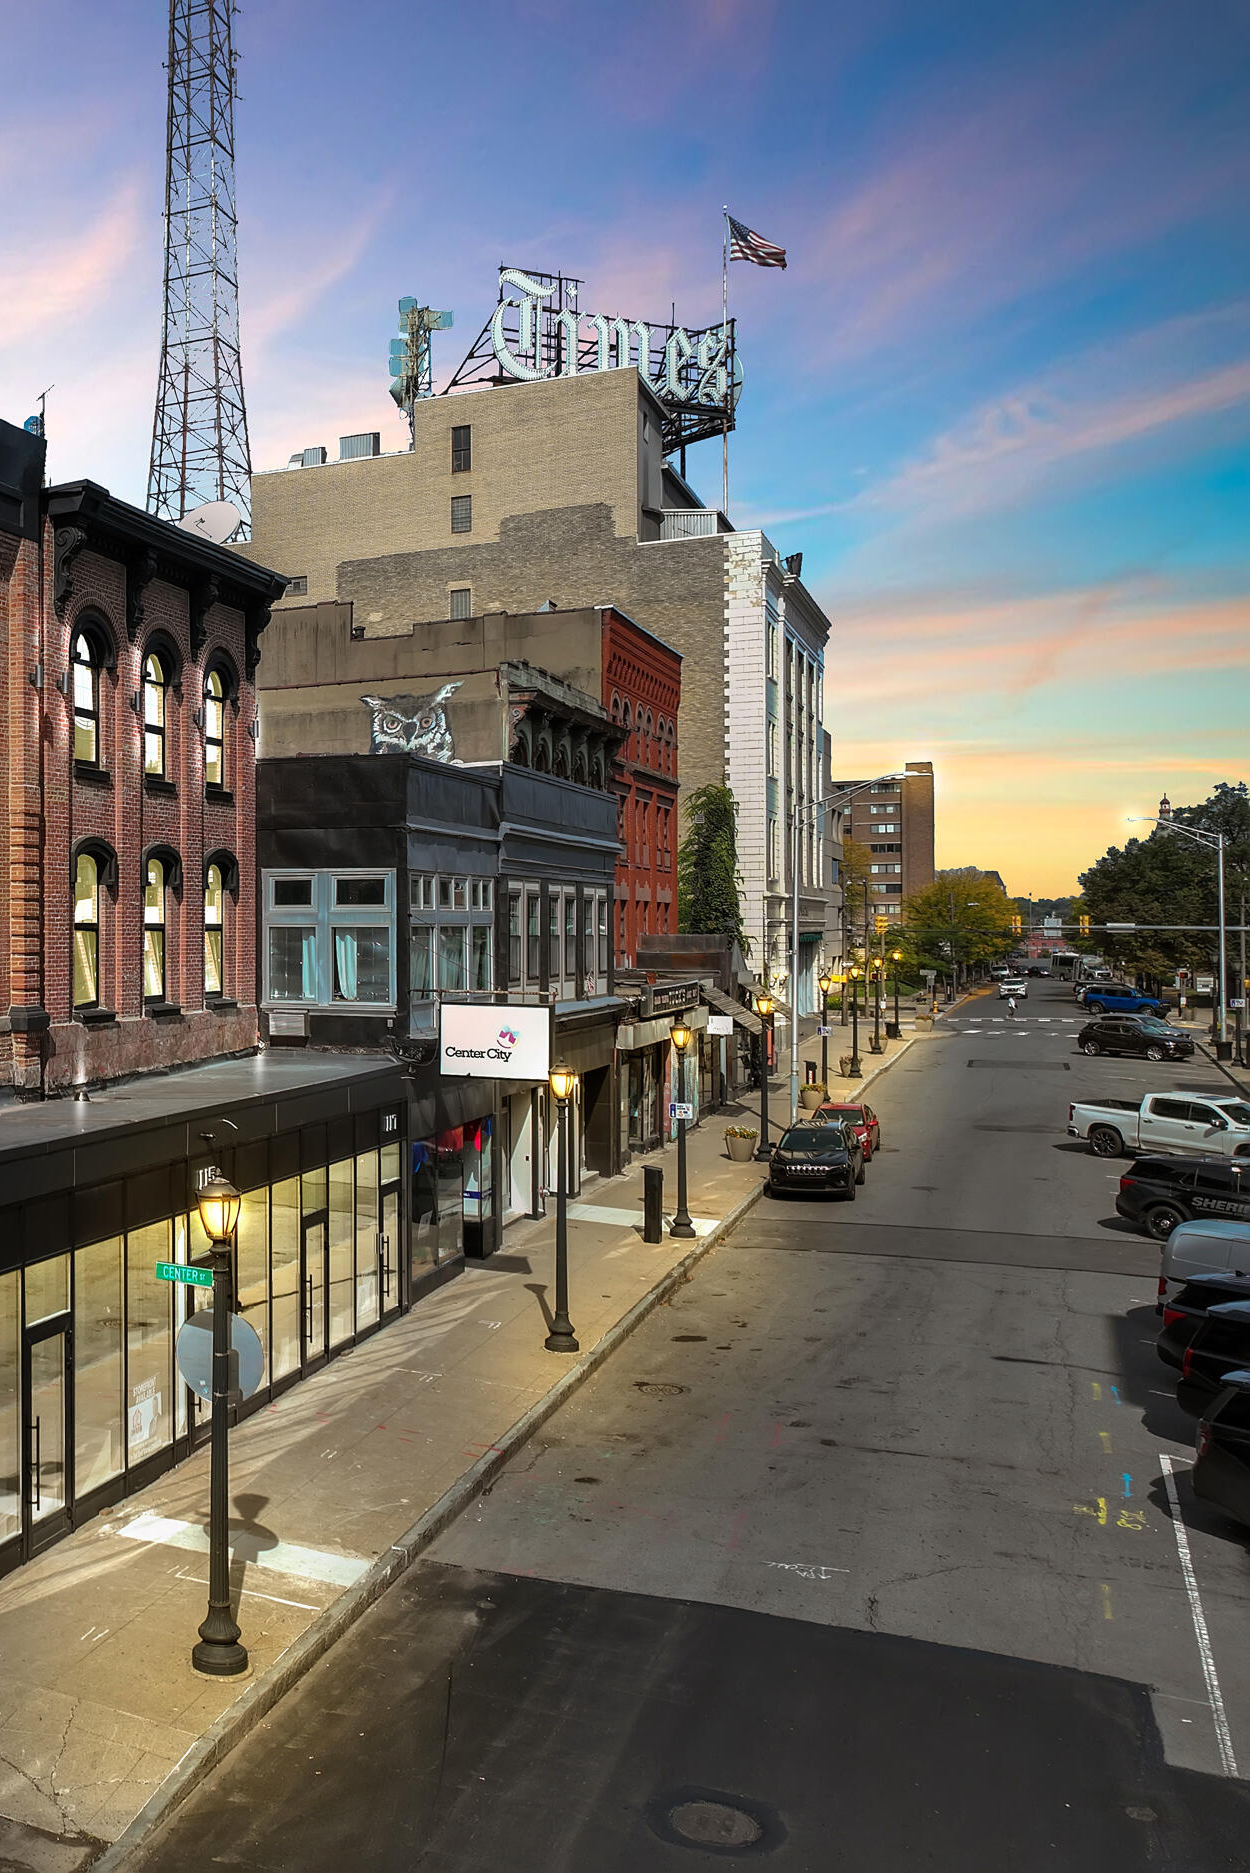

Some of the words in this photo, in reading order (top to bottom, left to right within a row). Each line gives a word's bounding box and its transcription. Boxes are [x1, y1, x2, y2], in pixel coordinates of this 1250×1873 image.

[491, 268, 727, 405] Times
[445, 1046, 486, 1059] Center
[487, 1048, 513, 1063] City
[198, 1165, 216, 1191] 115
[163, 1265, 199, 1282] CENTER
